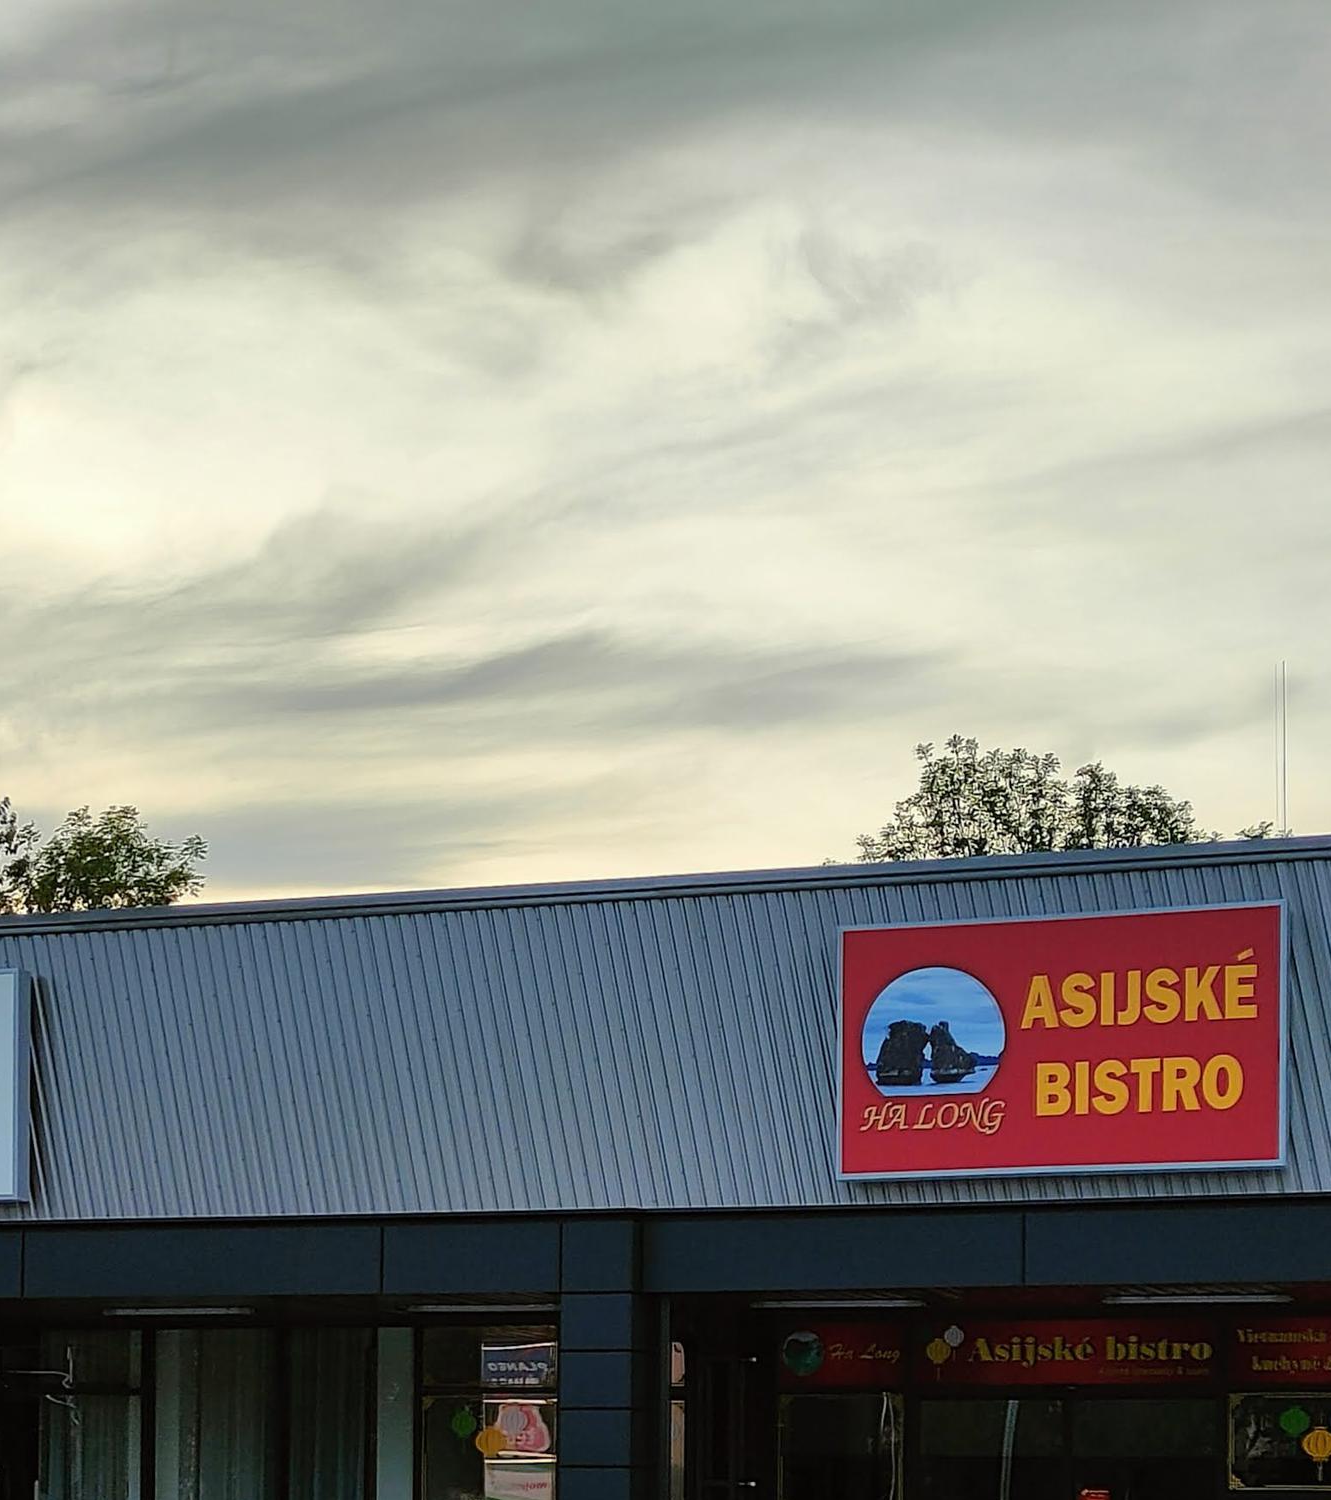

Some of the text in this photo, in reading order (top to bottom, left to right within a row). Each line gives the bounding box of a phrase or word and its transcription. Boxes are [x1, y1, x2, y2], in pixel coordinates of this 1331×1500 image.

[1020, 947, 1259, 1030] ASIJSKÉ
[1035, 1053, 1245, 1117] BISTRO
[860, 1097, 1006, 1136] HA LONG
[967, 1334, 1215, 1369] Asijské bistro
